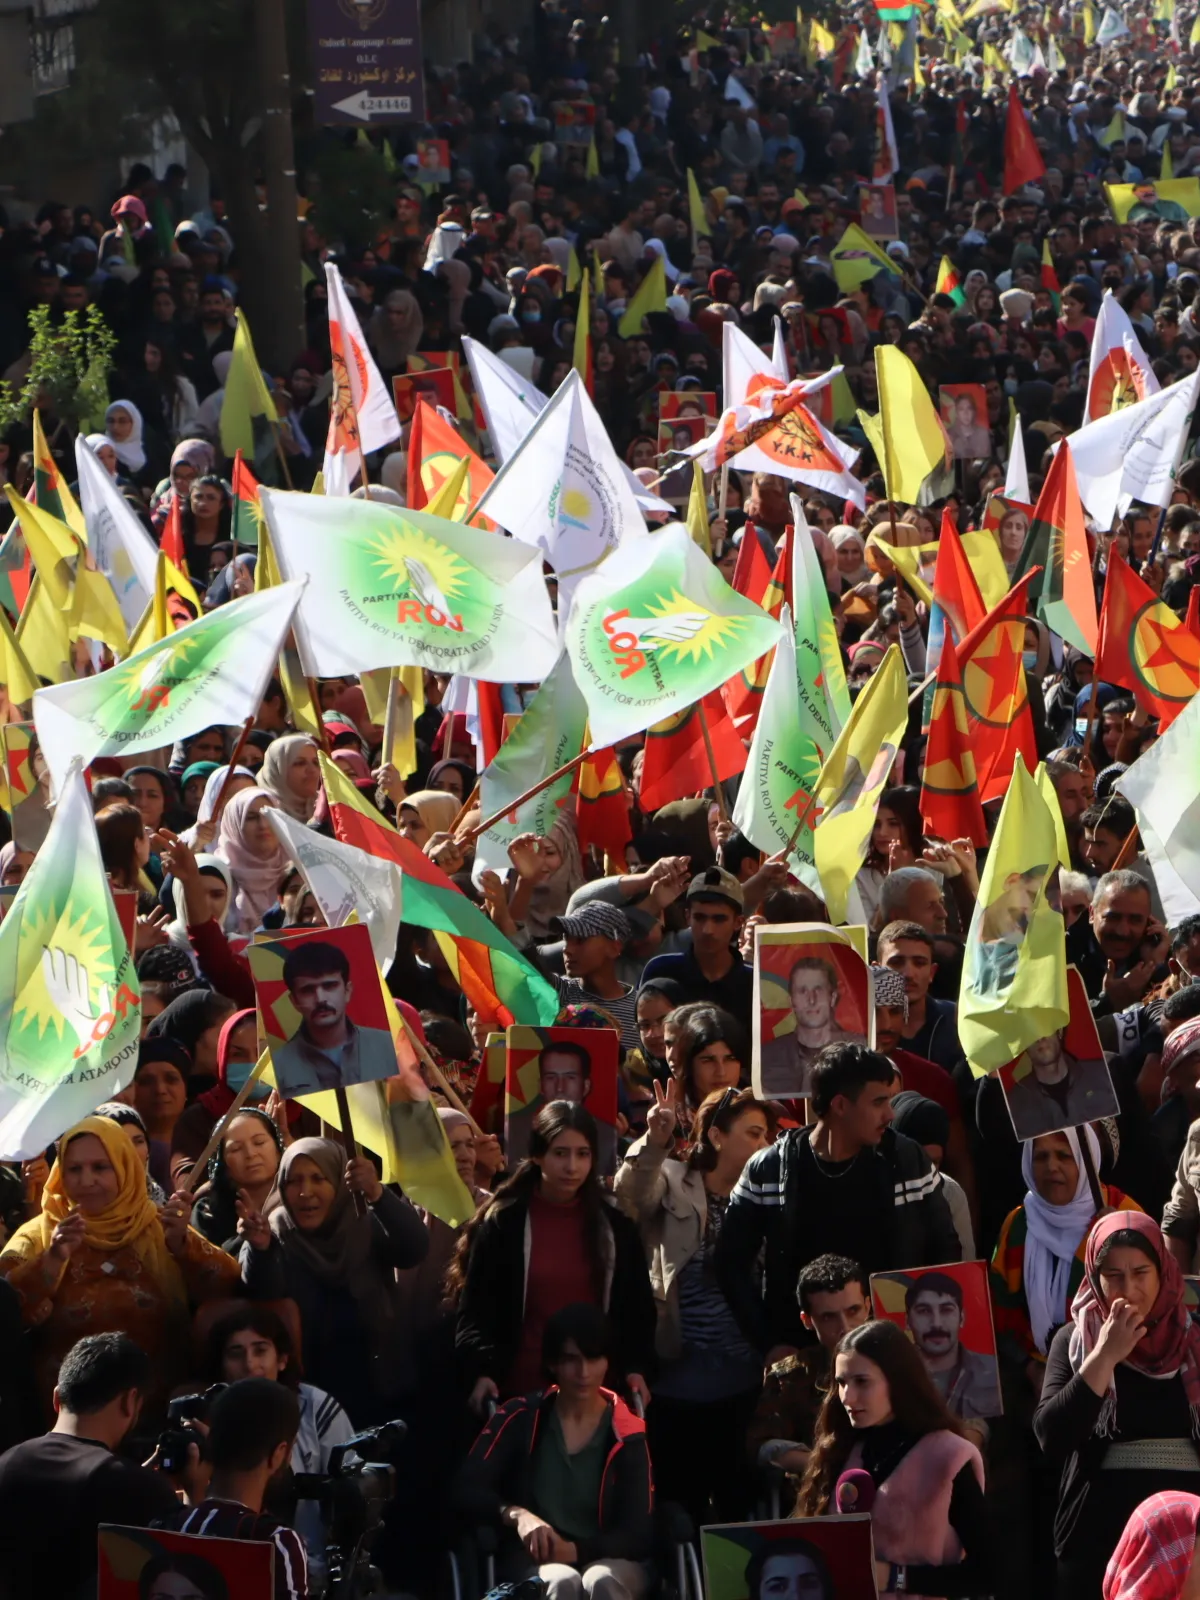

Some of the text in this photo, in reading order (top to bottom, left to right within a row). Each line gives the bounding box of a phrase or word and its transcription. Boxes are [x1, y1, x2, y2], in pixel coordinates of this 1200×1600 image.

[358, 99, 408, 111] 424446
[772, 440, 813, 463] Y.K.K
[339, 588, 370, 627] PARTIYA
[362, 592, 410, 604] PARTIYA
[802, 638, 819, 656] PAR
[808, 703, 834, 742] DEMUQ
[760, 739, 774, 787] PARTIYA
[774, 760, 813, 793] PARTIYA
